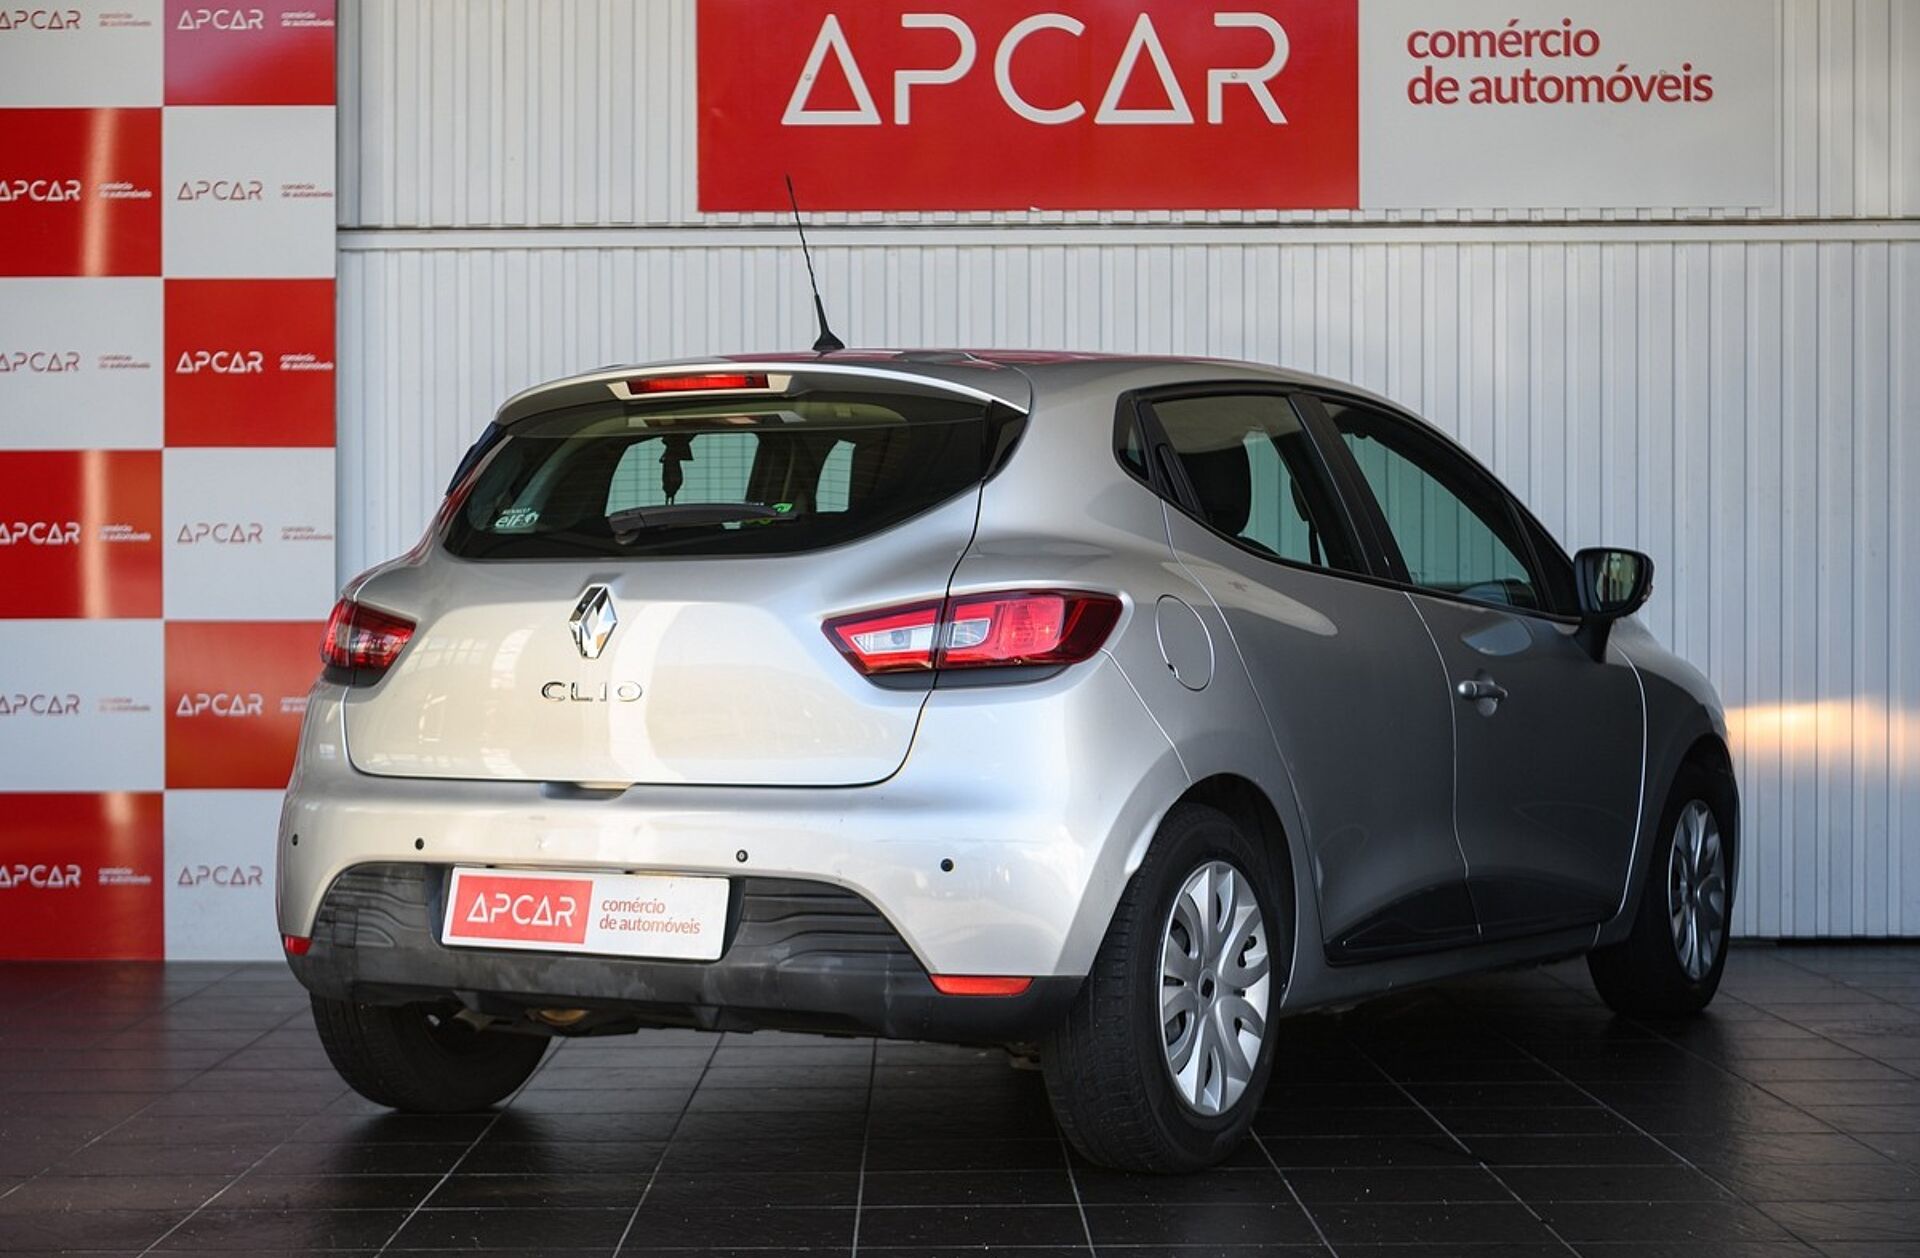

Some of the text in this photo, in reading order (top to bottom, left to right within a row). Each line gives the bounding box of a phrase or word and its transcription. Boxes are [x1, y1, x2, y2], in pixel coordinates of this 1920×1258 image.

[177, 9, 264, 30] APCAR
[1406, 20, 1600, 58] comércio
[781, 12, 1289, 126] APCAR
[1406, 63, 1714, 106] de automóveis
[177, 181, 263, 201] APCAR
[176, 351, 263, 373] APCAR
[177, 523, 263, 543] APCAR
[541, 681, 644, 703] CLIO
[176, 693, 263, 716] APCAR
[177, 866, 263, 886] APCAR
[467, 892, 577, 928] APCAR
[601, 897, 666, 914] comércio
[600, 916, 701, 934] de automóveis
